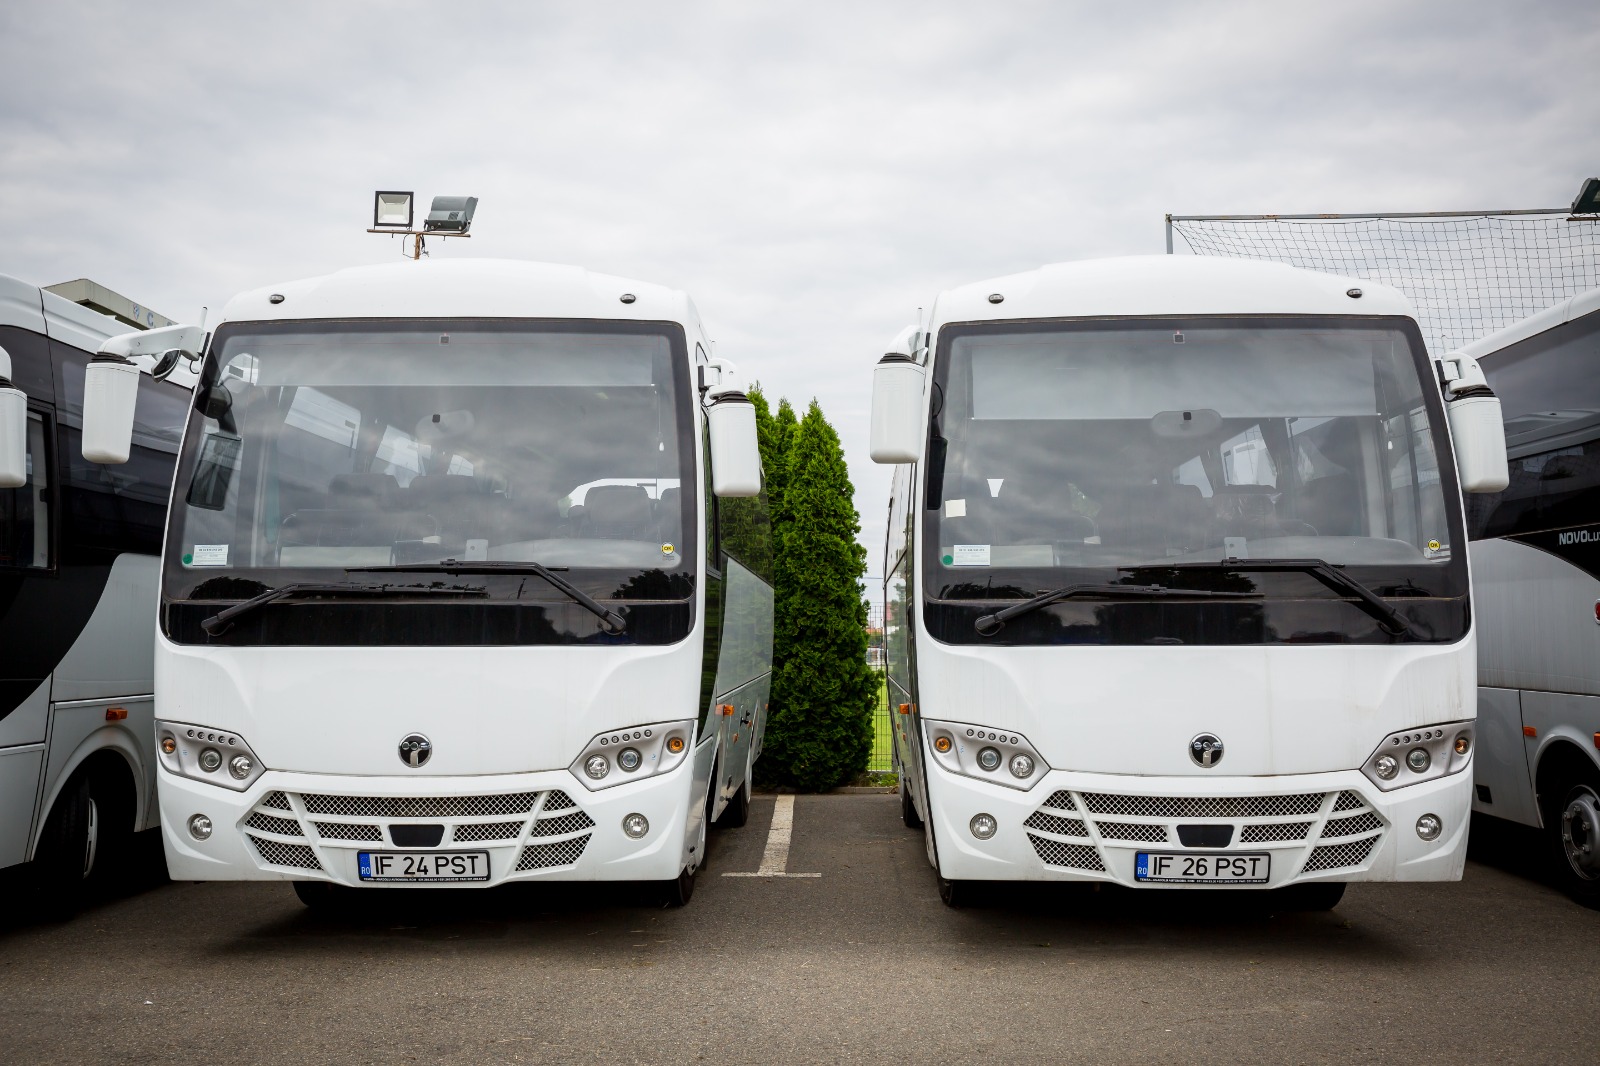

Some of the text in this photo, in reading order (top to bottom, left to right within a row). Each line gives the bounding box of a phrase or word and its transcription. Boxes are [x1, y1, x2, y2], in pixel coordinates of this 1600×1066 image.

[1559, 530, 1600, 545] NOVOLU
[361, 855, 479, 875] RO IF 24 PST
[1137, 857, 1261, 877] RO IF 26 PST
